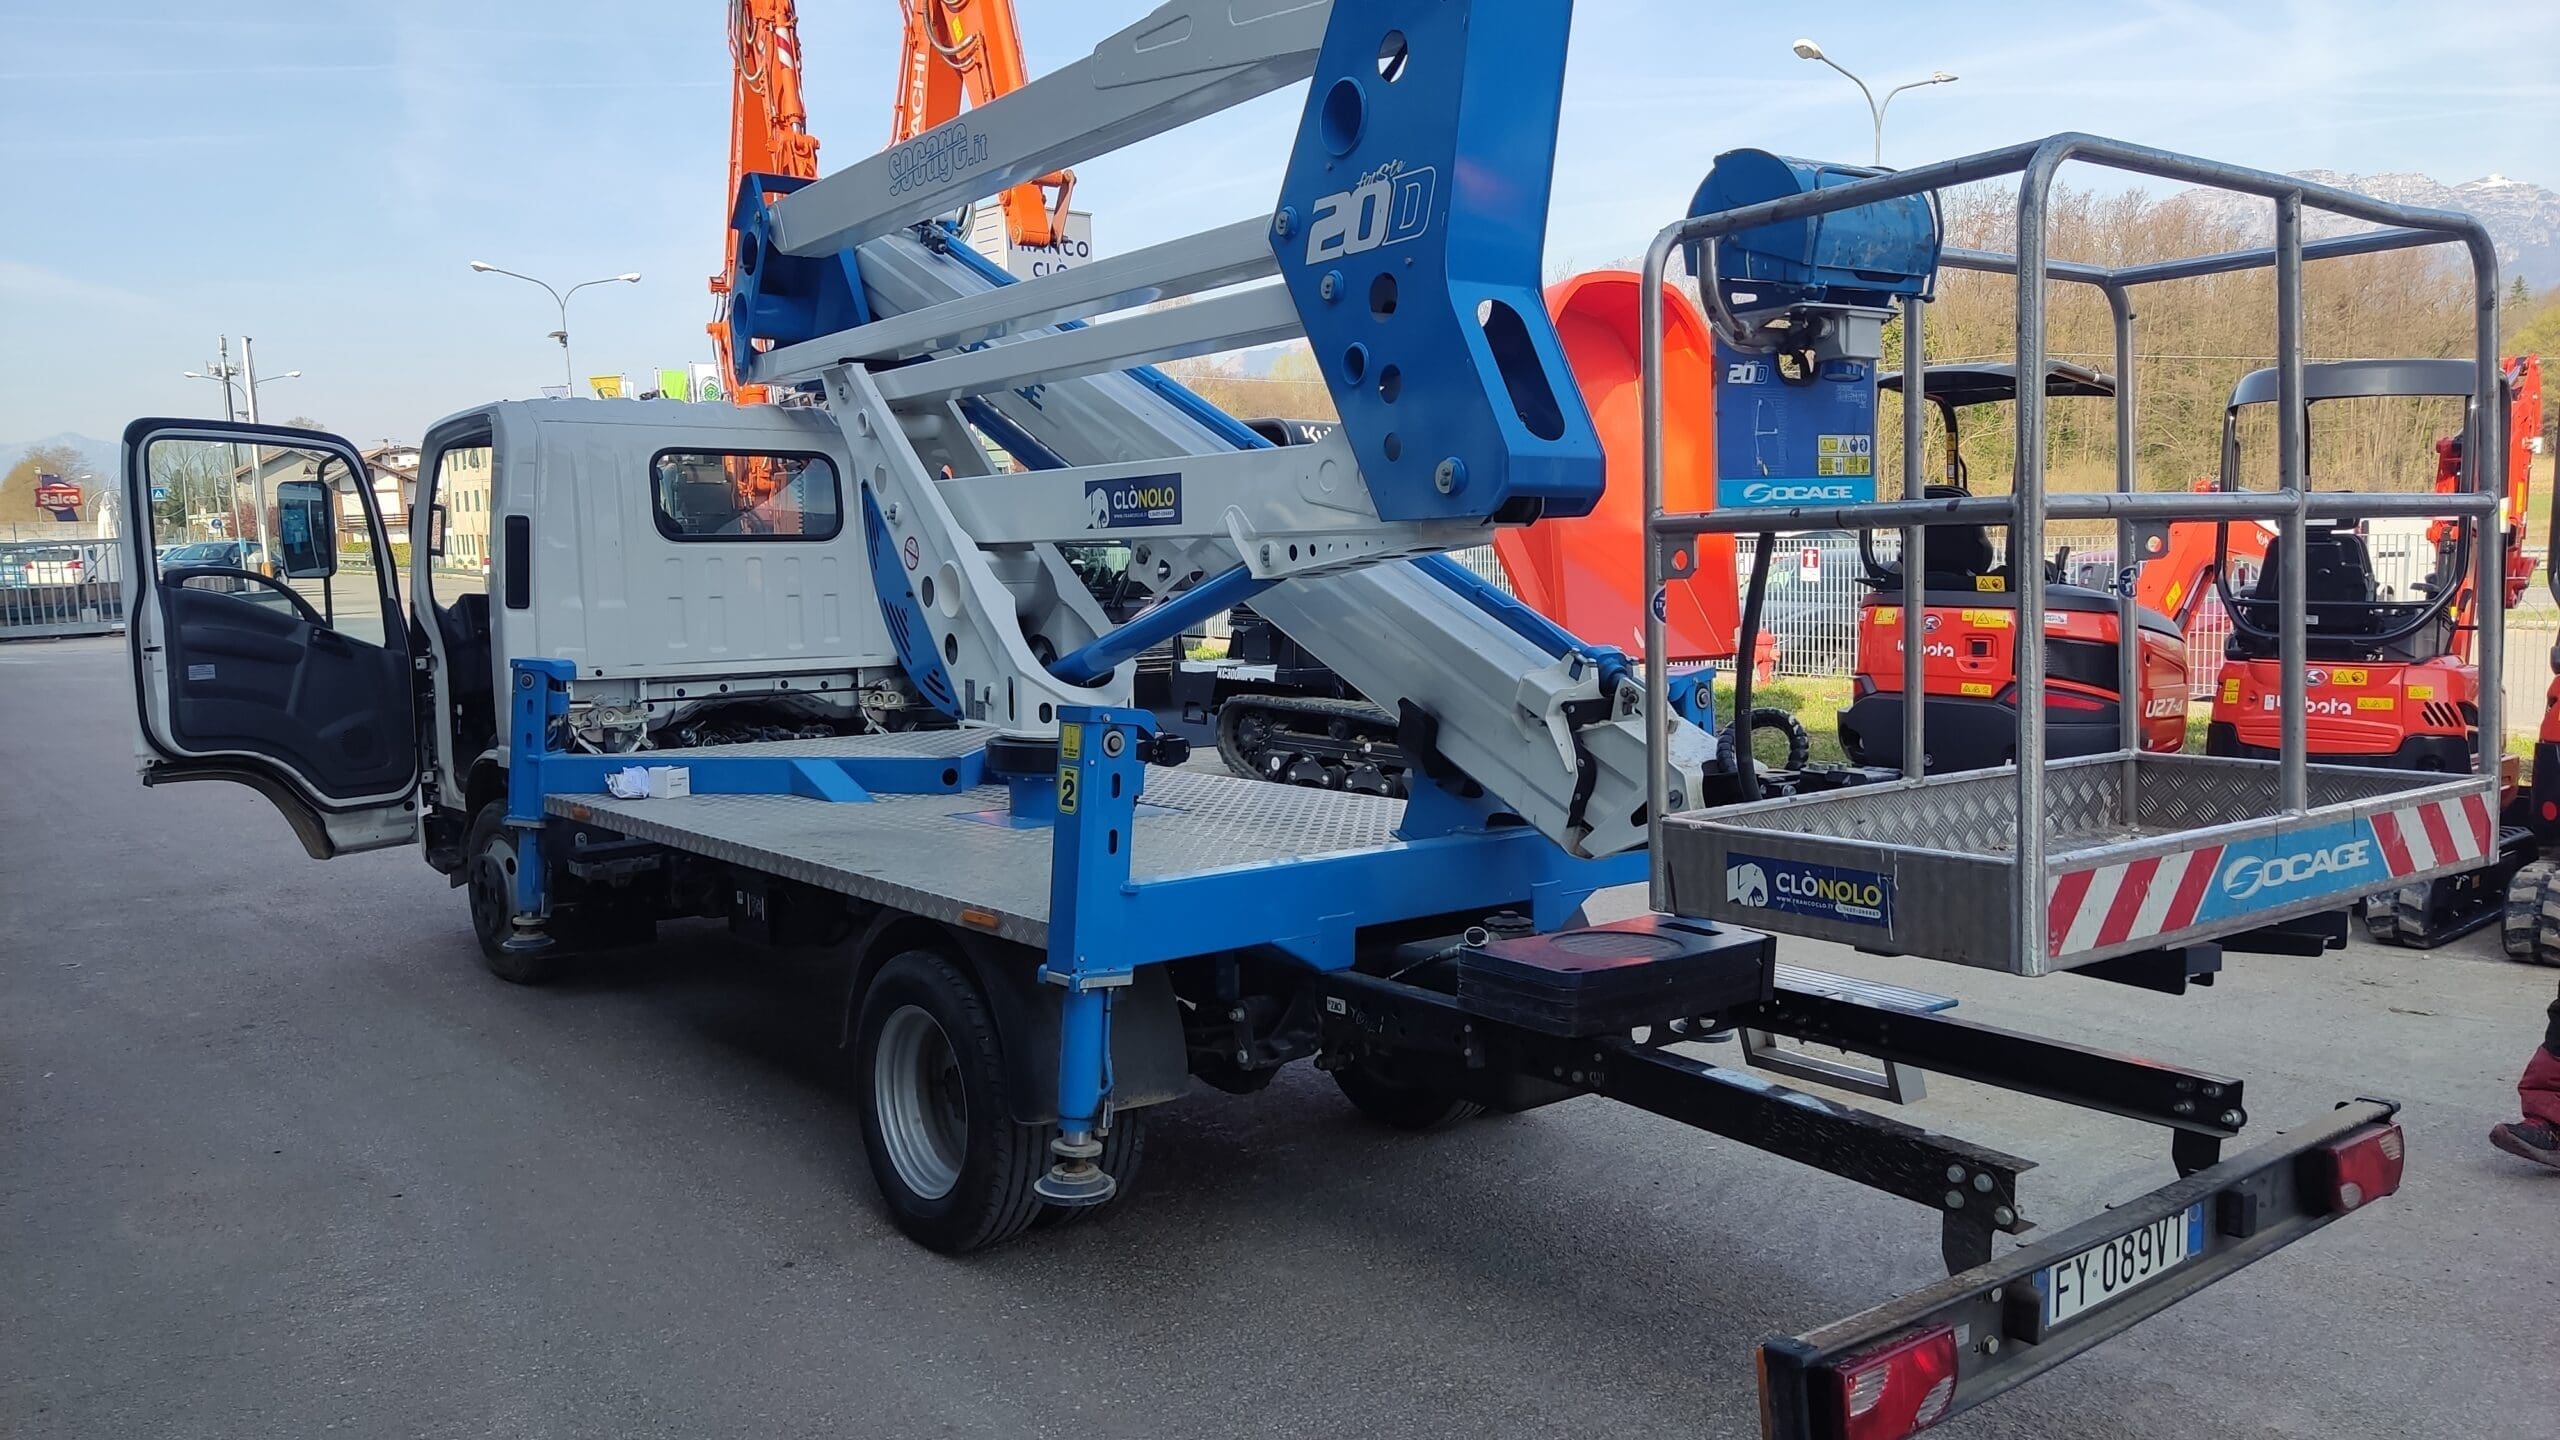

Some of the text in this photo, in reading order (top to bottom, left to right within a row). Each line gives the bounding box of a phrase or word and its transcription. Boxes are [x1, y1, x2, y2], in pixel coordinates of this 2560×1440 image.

[888, 122, 988, 197] socage.it
[1305, 166, 1437, 265] 20D
[40, 493, 79, 505] Salce
[1113, 484, 1175, 509] CLÒNOLO
[1743, 483, 1853, 503] SOCAGE
[2145, 698, 2184, 718] U27-4
[1061, 779, 1075, 807] 2
[2223, 839, 2370, 900] SOCAGE
[1775, 870, 1882, 907] CLÒNOLO
[2056, 1254, 2090, 1319] FY
